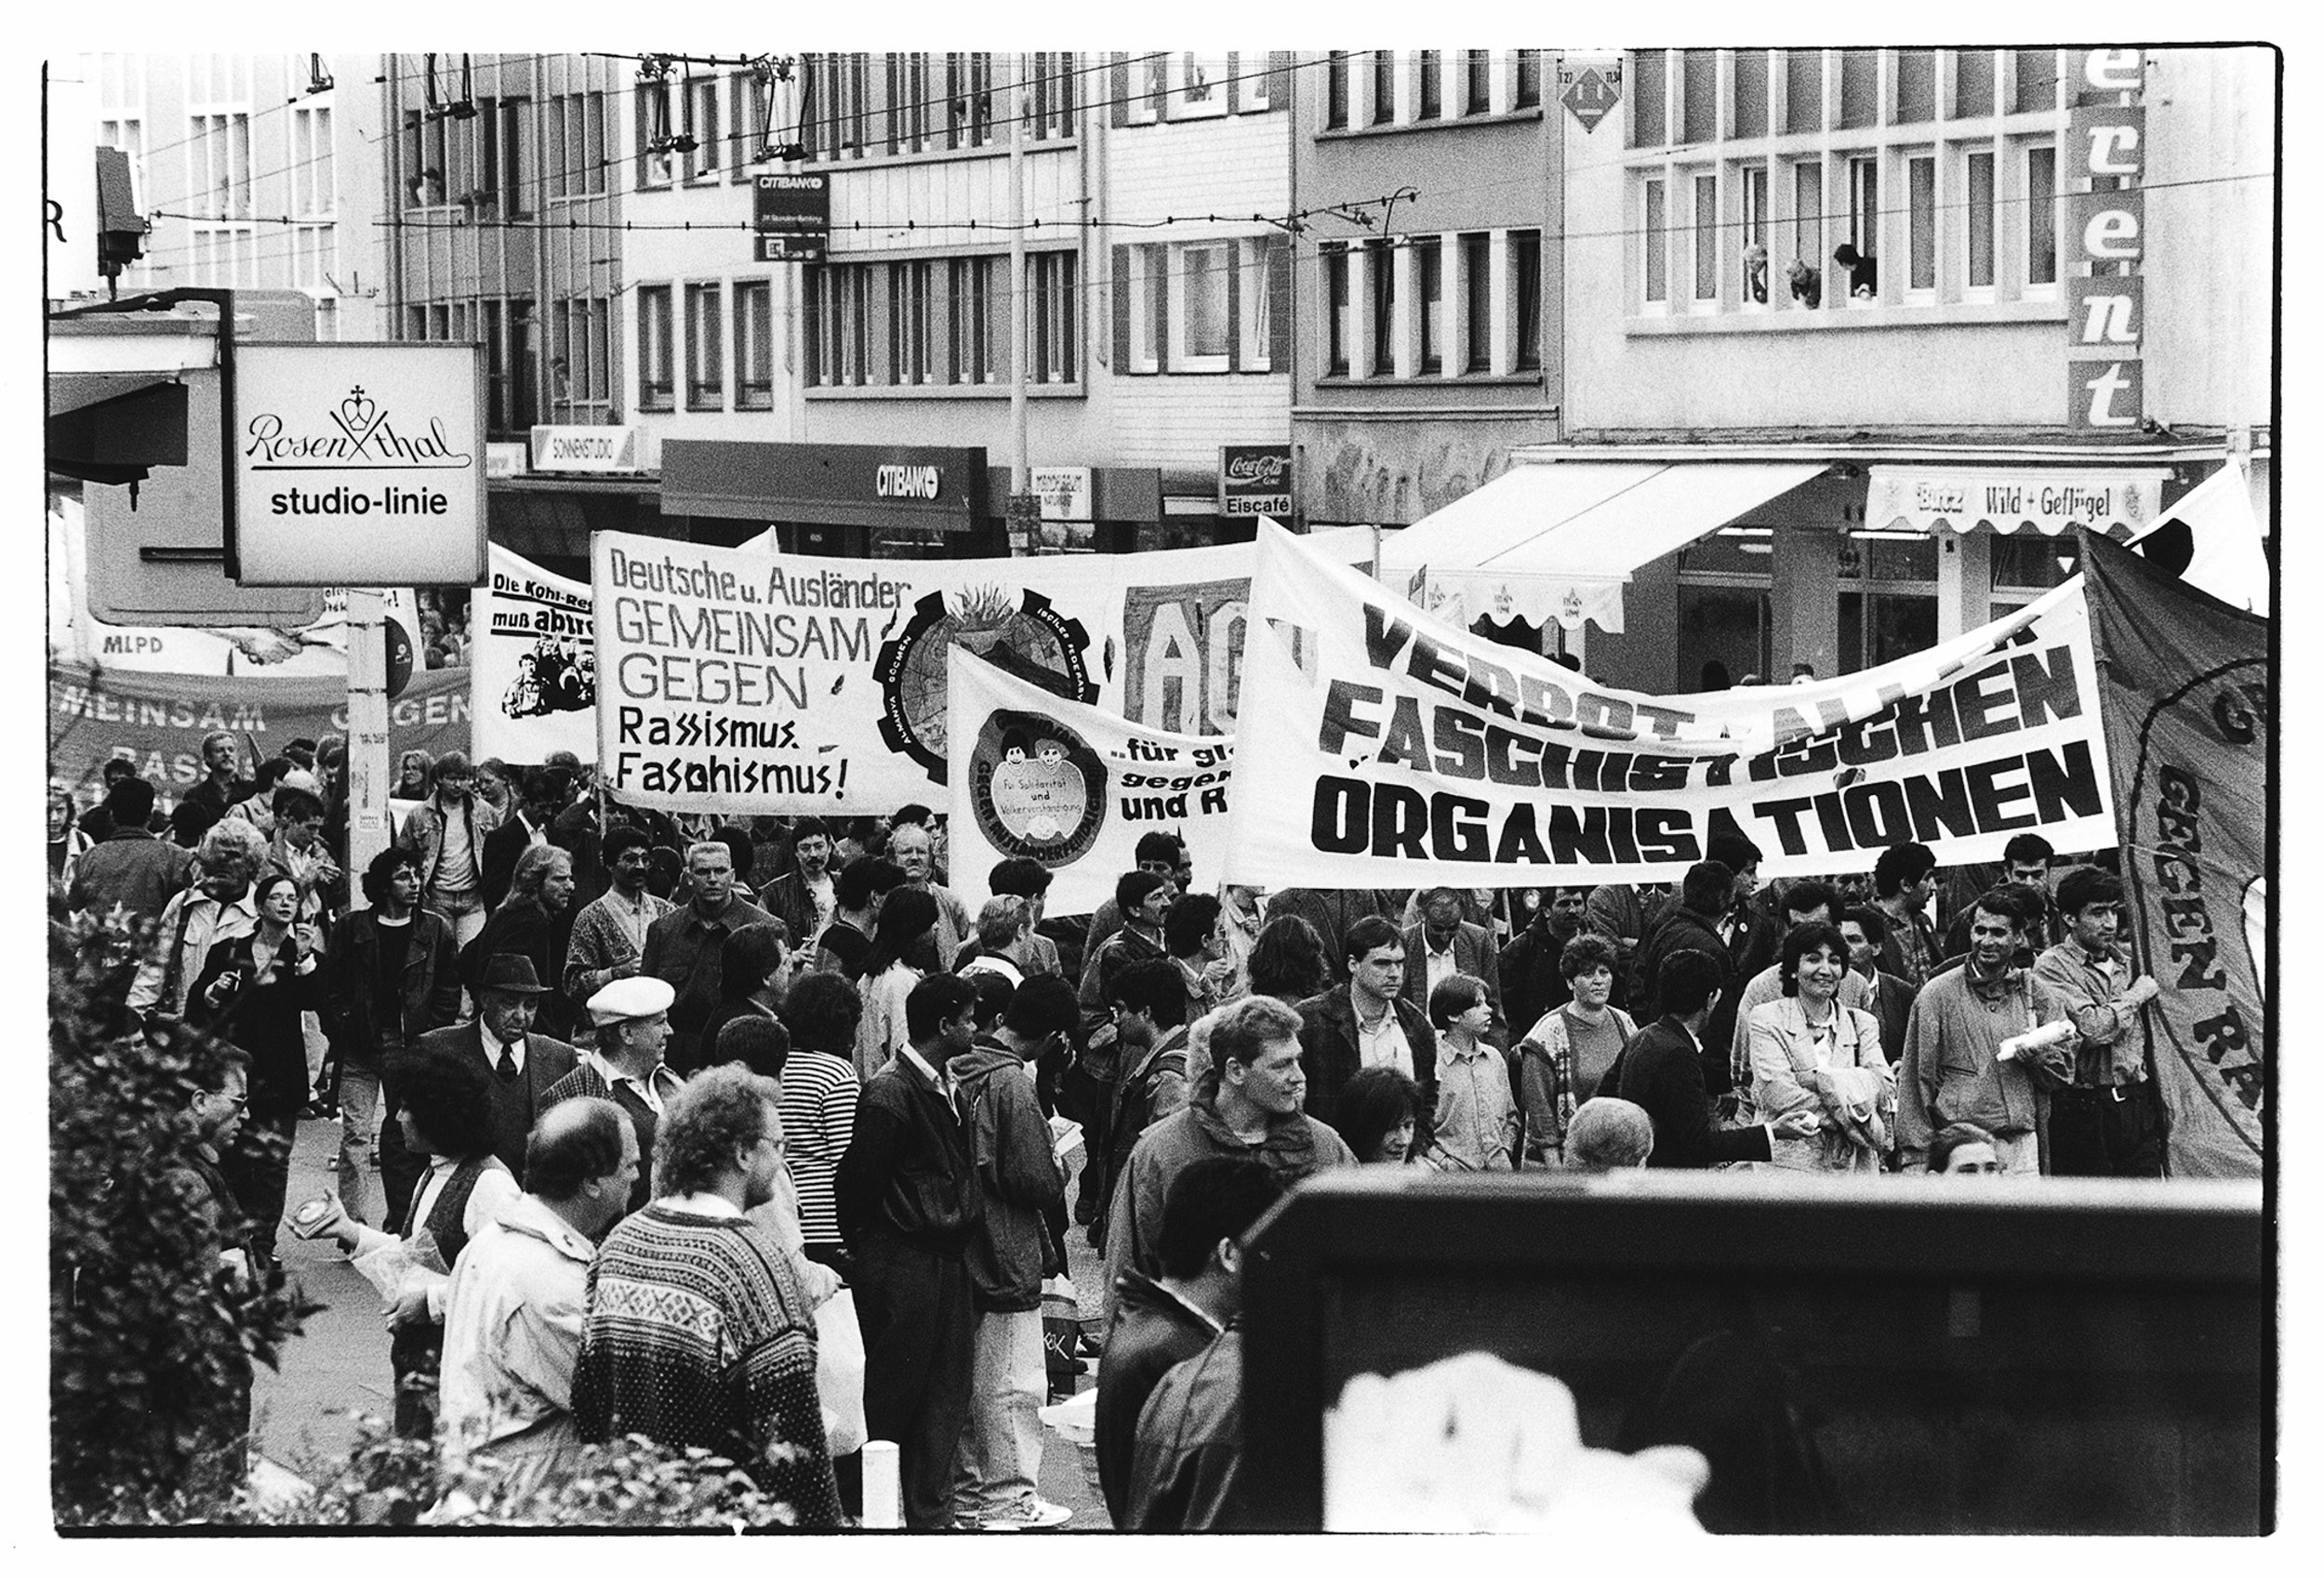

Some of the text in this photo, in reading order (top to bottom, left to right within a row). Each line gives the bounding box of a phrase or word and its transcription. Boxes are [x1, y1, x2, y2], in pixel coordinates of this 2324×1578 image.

[759, 176, 814, 189] CITIBANK
[246, 413, 471, 465] Rosenthal
[876, 465, 927, 498] CITIBANK
[1229, 455, 1292, 477] Coca-Cola
[271, 485, 448, 515] studio-linie
[1227, 497, 1289, 513] Eiscafé
[1986, 486, 2021, 514] Wild
[2041, 486, 2111, 523] Geflügel
[494, 573, 521, 592] Die
[610, 548, 912, 609] Deutsche u. Ausländer
[492, 612, 530, 629] muß
[615, 596, 870, 662] GEMEINSAM
[102, 635, 164, 654] MLPD
[618, 652, 808, 710] GEGEN
[330, 694, 472, 731] GGEN
[616, 751, 848, 800] Faschismus!
[1030, 790, 1051, 802] und
[1121, 792, 1189, 821] und
[1310, 739, 2105, 865] ORGANISATIONEN
[2154, 764, 2227, 990] GEGEN
